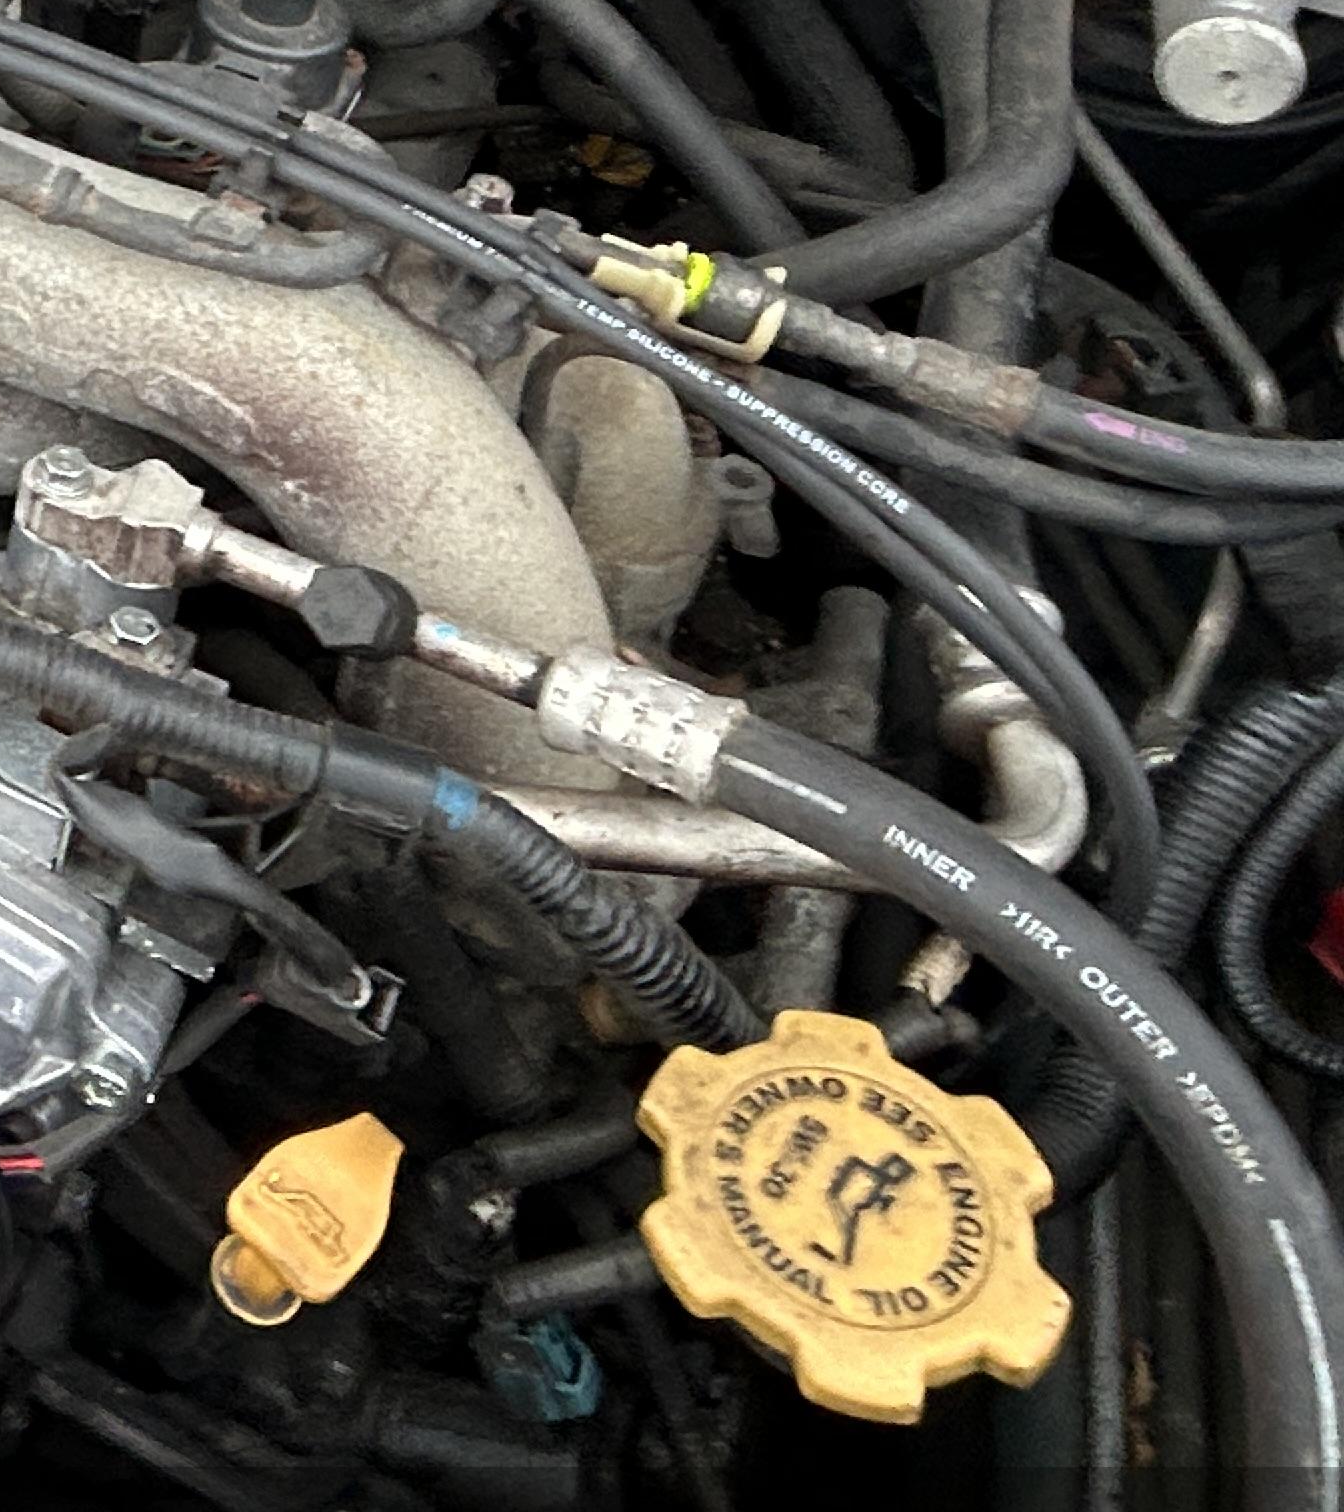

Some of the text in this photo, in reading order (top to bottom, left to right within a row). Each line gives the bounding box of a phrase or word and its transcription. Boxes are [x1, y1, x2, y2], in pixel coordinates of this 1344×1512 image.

[725, 384, 858, 474] SUPPRESSION
[856, 470, 911, 515] CORE
[883, 824, 977, 891] INNER
[1079, 966, 1179, 1060] OUTER
[859, 1087, 936, 1143] SEE
[718, 1174, 834, 1306] MANUAL
[854, 1161, 985, 1317] ENGINE OIL
